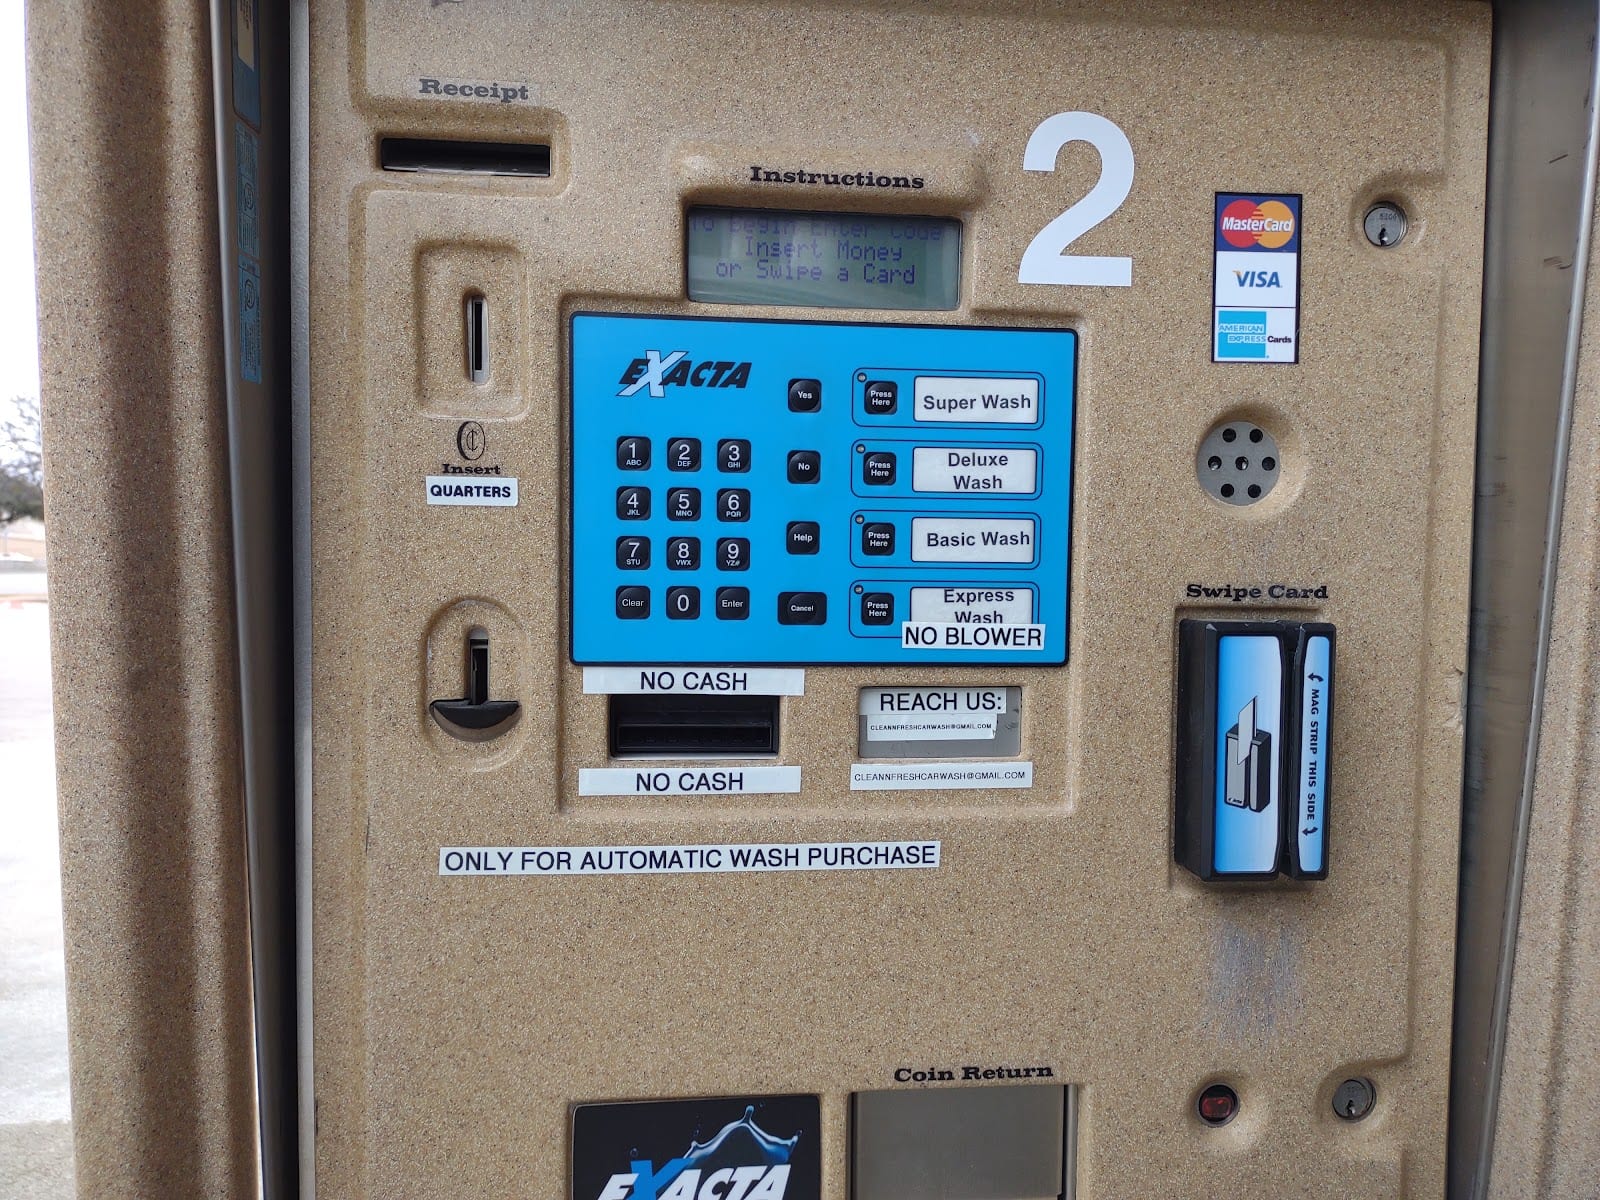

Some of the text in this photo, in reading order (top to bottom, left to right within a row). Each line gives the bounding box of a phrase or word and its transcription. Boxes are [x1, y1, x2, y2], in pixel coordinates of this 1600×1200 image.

[418, 78, 530, 103] Receipt
[750, 166, 924, 189] Instructions
[1018, 111, 1135, 287] 2
[1222, 216, 1292, 232] MasterCard
[745, 236, 902, 262] Insert Money
[716, 259, 915, 285] or Swipe a Card
[1233, 270, 1282, 288] VISA
[1219, 324, 1263, 332] AMERICAN
[1229, 335, 1292, 343] EXPRESS Cards
[616, 350, 752, 398] EXACTA
[797, 391, 813, 399] Yes
[872, 398, 890, 406] Here
[923, 394, 1031, 413] Super Wash
[629, 442, 740, 461] 1 2 3
[948, 452, 1009, 467] Deluxe
[442, 463, 501, 474] Insert
[798, 462, 810, 471] No
[869, 461, 891, 469] Press
[871, 469, 889, 477] Here
[430, 484, 511, 498] QUARTERS
[953, 475, 1003, 490] Wash
[627, 493, 740, 510] 4 5 6
[793, 533, 813, 543] Help
[927, 531, 1030, 547] Basic Wash
[628, 542, 740, 560] 7 8 9
[944, 589, 1015, 606] Express
[1186, 583, 1329, 601] Swipe Card
[622, 598, 645, 607] Clear
[677, 595, 690, 612] 0
[722, 600, 744, 608] Enter
[955, 611, 1003, 624] Wash
[905, 627, 1042, 646] NO BLOWER
[640, 671, 748, 691] NO CASH
[880, 692, 1001, 711] REACH US:
[870, 723, 992, 731] CLEANNFRESHCARWASH@GMAIL.COM
[1306, 689, 1320, 820] MAG STRIP THIS SIDE
[636, 772, 744, 791] NO CASH
[854, 771, 1026, 782] CLEANNFRESHCARWASH@GMAIL.COM
[445, 845, 936, 873] ONLY FOR AUTOMATIC WASH PURCHASE
[894, 1066, 1053, 1083] Coin Return
[597, 1157, 791, 1200] EXACTA
